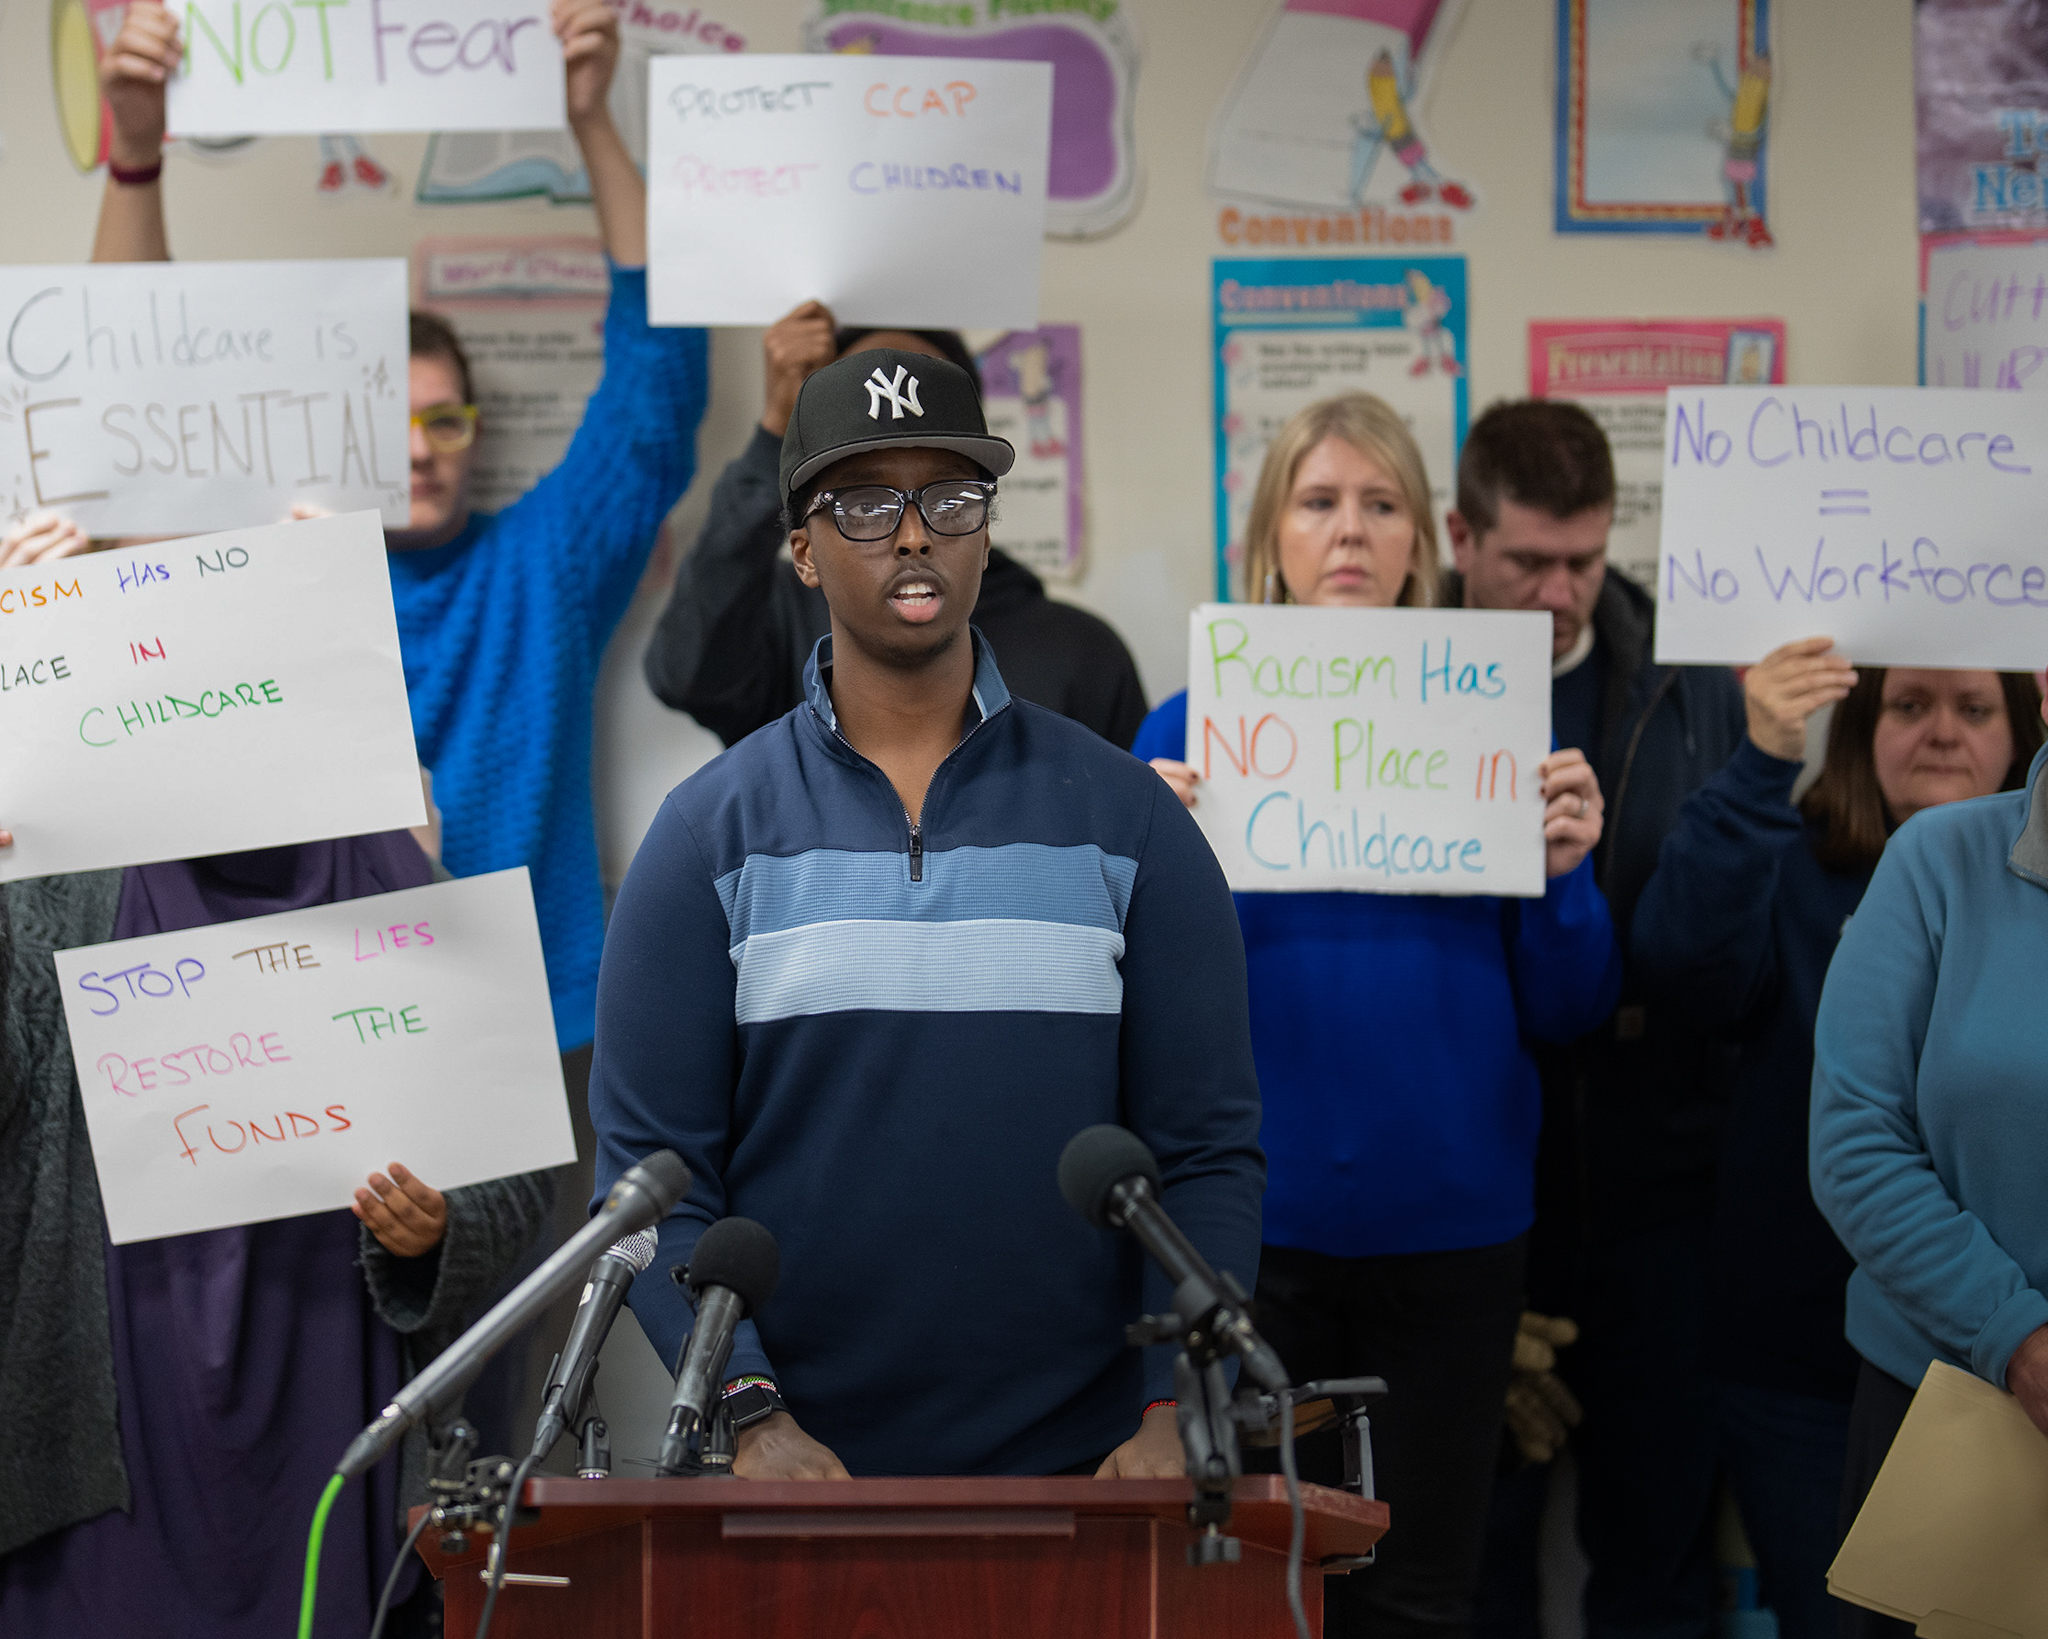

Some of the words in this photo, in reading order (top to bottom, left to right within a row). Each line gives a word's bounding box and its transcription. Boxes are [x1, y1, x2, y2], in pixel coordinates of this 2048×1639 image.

[182, 0, 349, 85] NOT
[669, 80, 833, 123] PROTECT
[864, 79, 978, 118] CCAP
[671, 154, 821, 199] PROTECT
[850, 161, 1023, 196] CHILDREN
[1218, 206, 1454, 245] Conventions
[5, 286, 274, 383] Childcare
[314, 320, 359, 361] is
[24, 388, 402, 506] ESSENTIAL
[1672, 398, 1732, 467] No
[1747, 396, 2032, 476] Childcare
[196, 546, 249, 577] NO
[1667, 548, 1739, 605] No
[1755, 536, 2048, 608] Workforce
[130, 637, 166, 664] IN
[1206, 618, 1397, 700] Racism
[1421, 637, 1507, 704] Has
[79, 678, 284, 747] CHILDCARE
[1202, 713, 1298, 782] NO
[1331, 718, 1448, 792] Place
[1245, 790, 1486, 878] Childcare
[78, 957, 206, 1017] STOP
[232, 941, 322, 974] THE
[353, 921, 435, 963] LIES
[96, 1031, 293, 1098] RESTORE
[332, 1004, 428, 1044] THE
[173, 1103, 352, 1166] FUNDS
